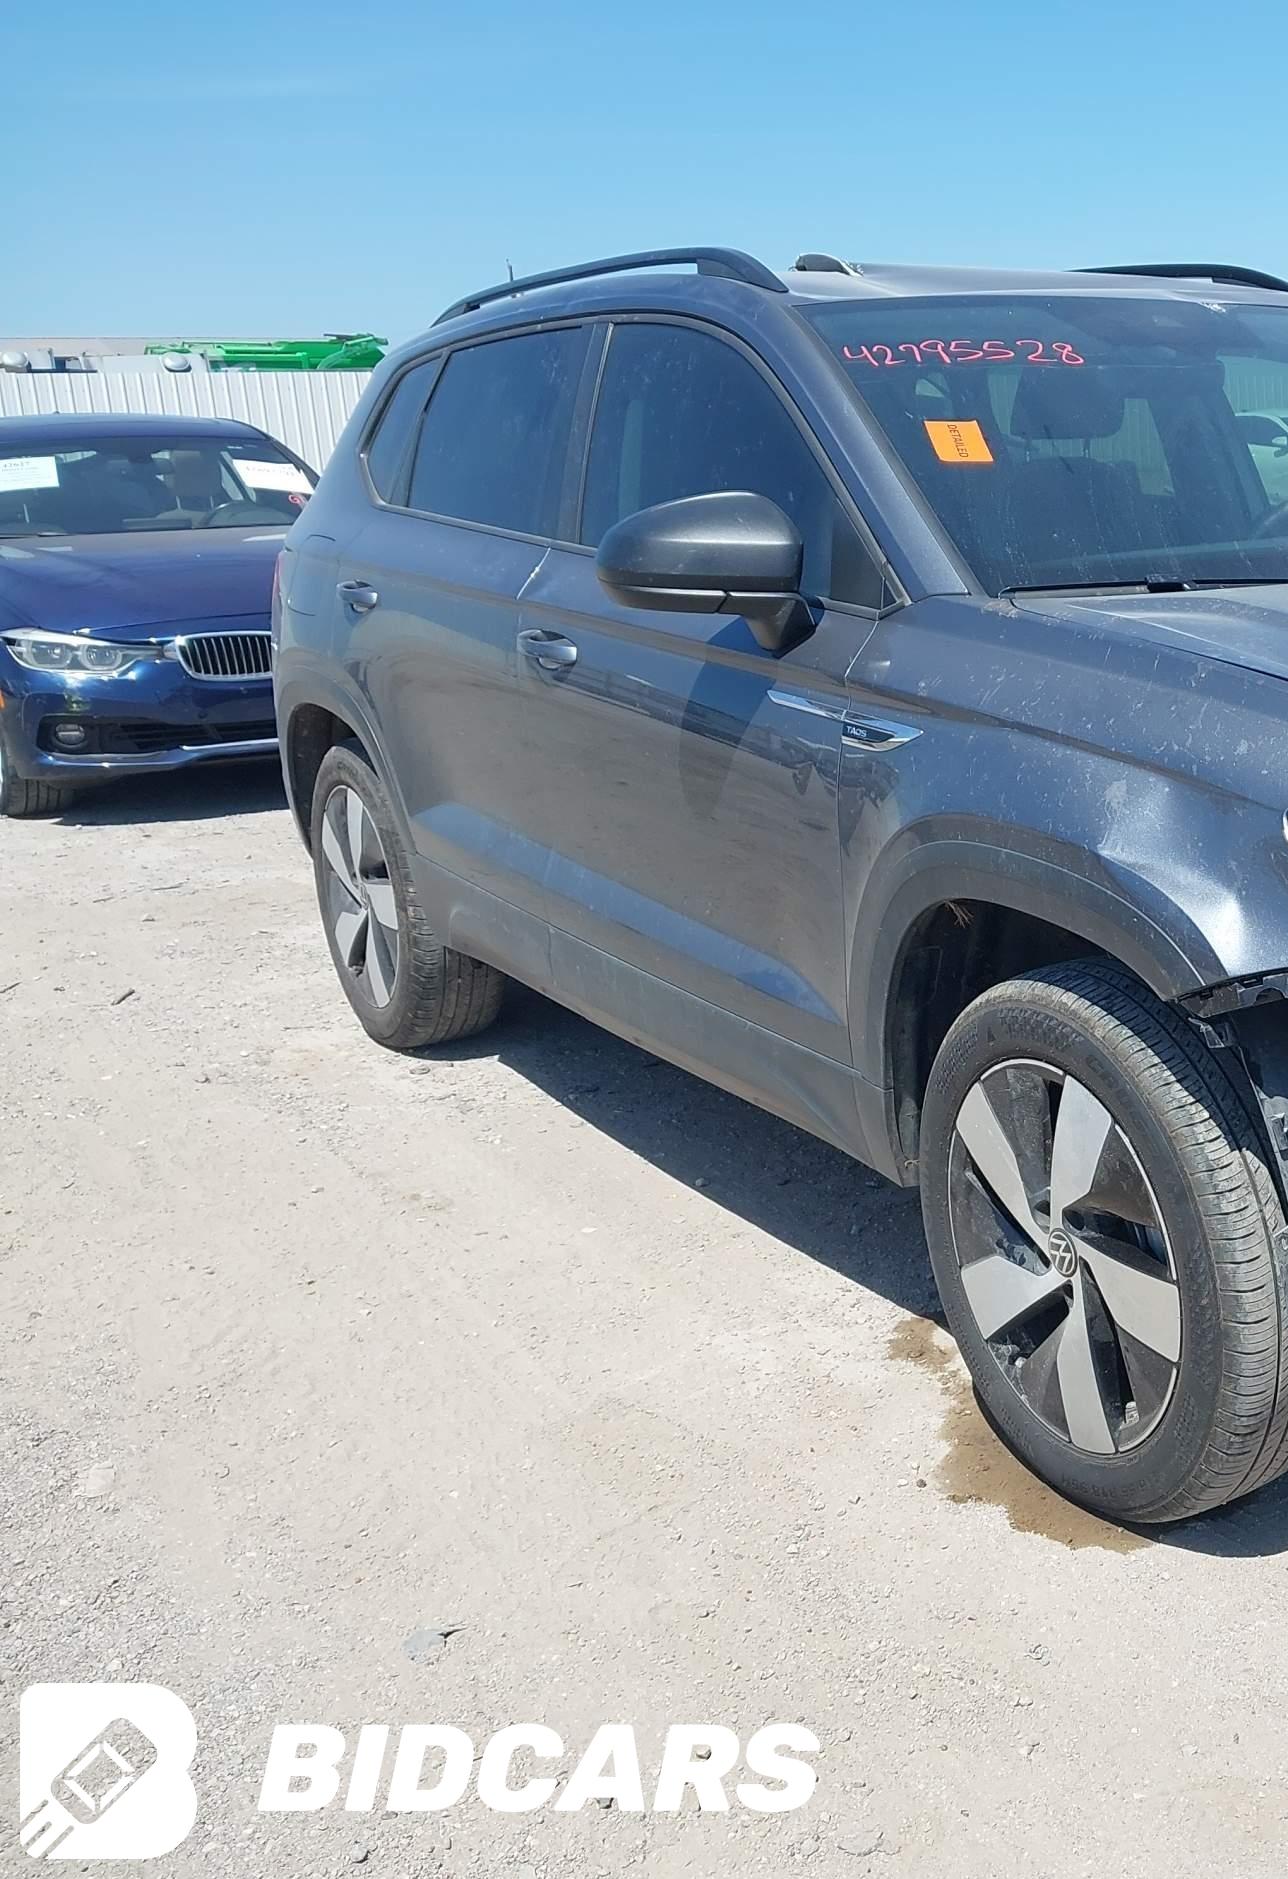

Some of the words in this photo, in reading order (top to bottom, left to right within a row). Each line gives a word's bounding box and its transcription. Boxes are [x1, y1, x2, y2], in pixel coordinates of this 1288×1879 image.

[843, 339, 1085, 367] 42795528
[947, 424, 969, 458] DETAILED
[846, 726, 868, 738] TAOS
